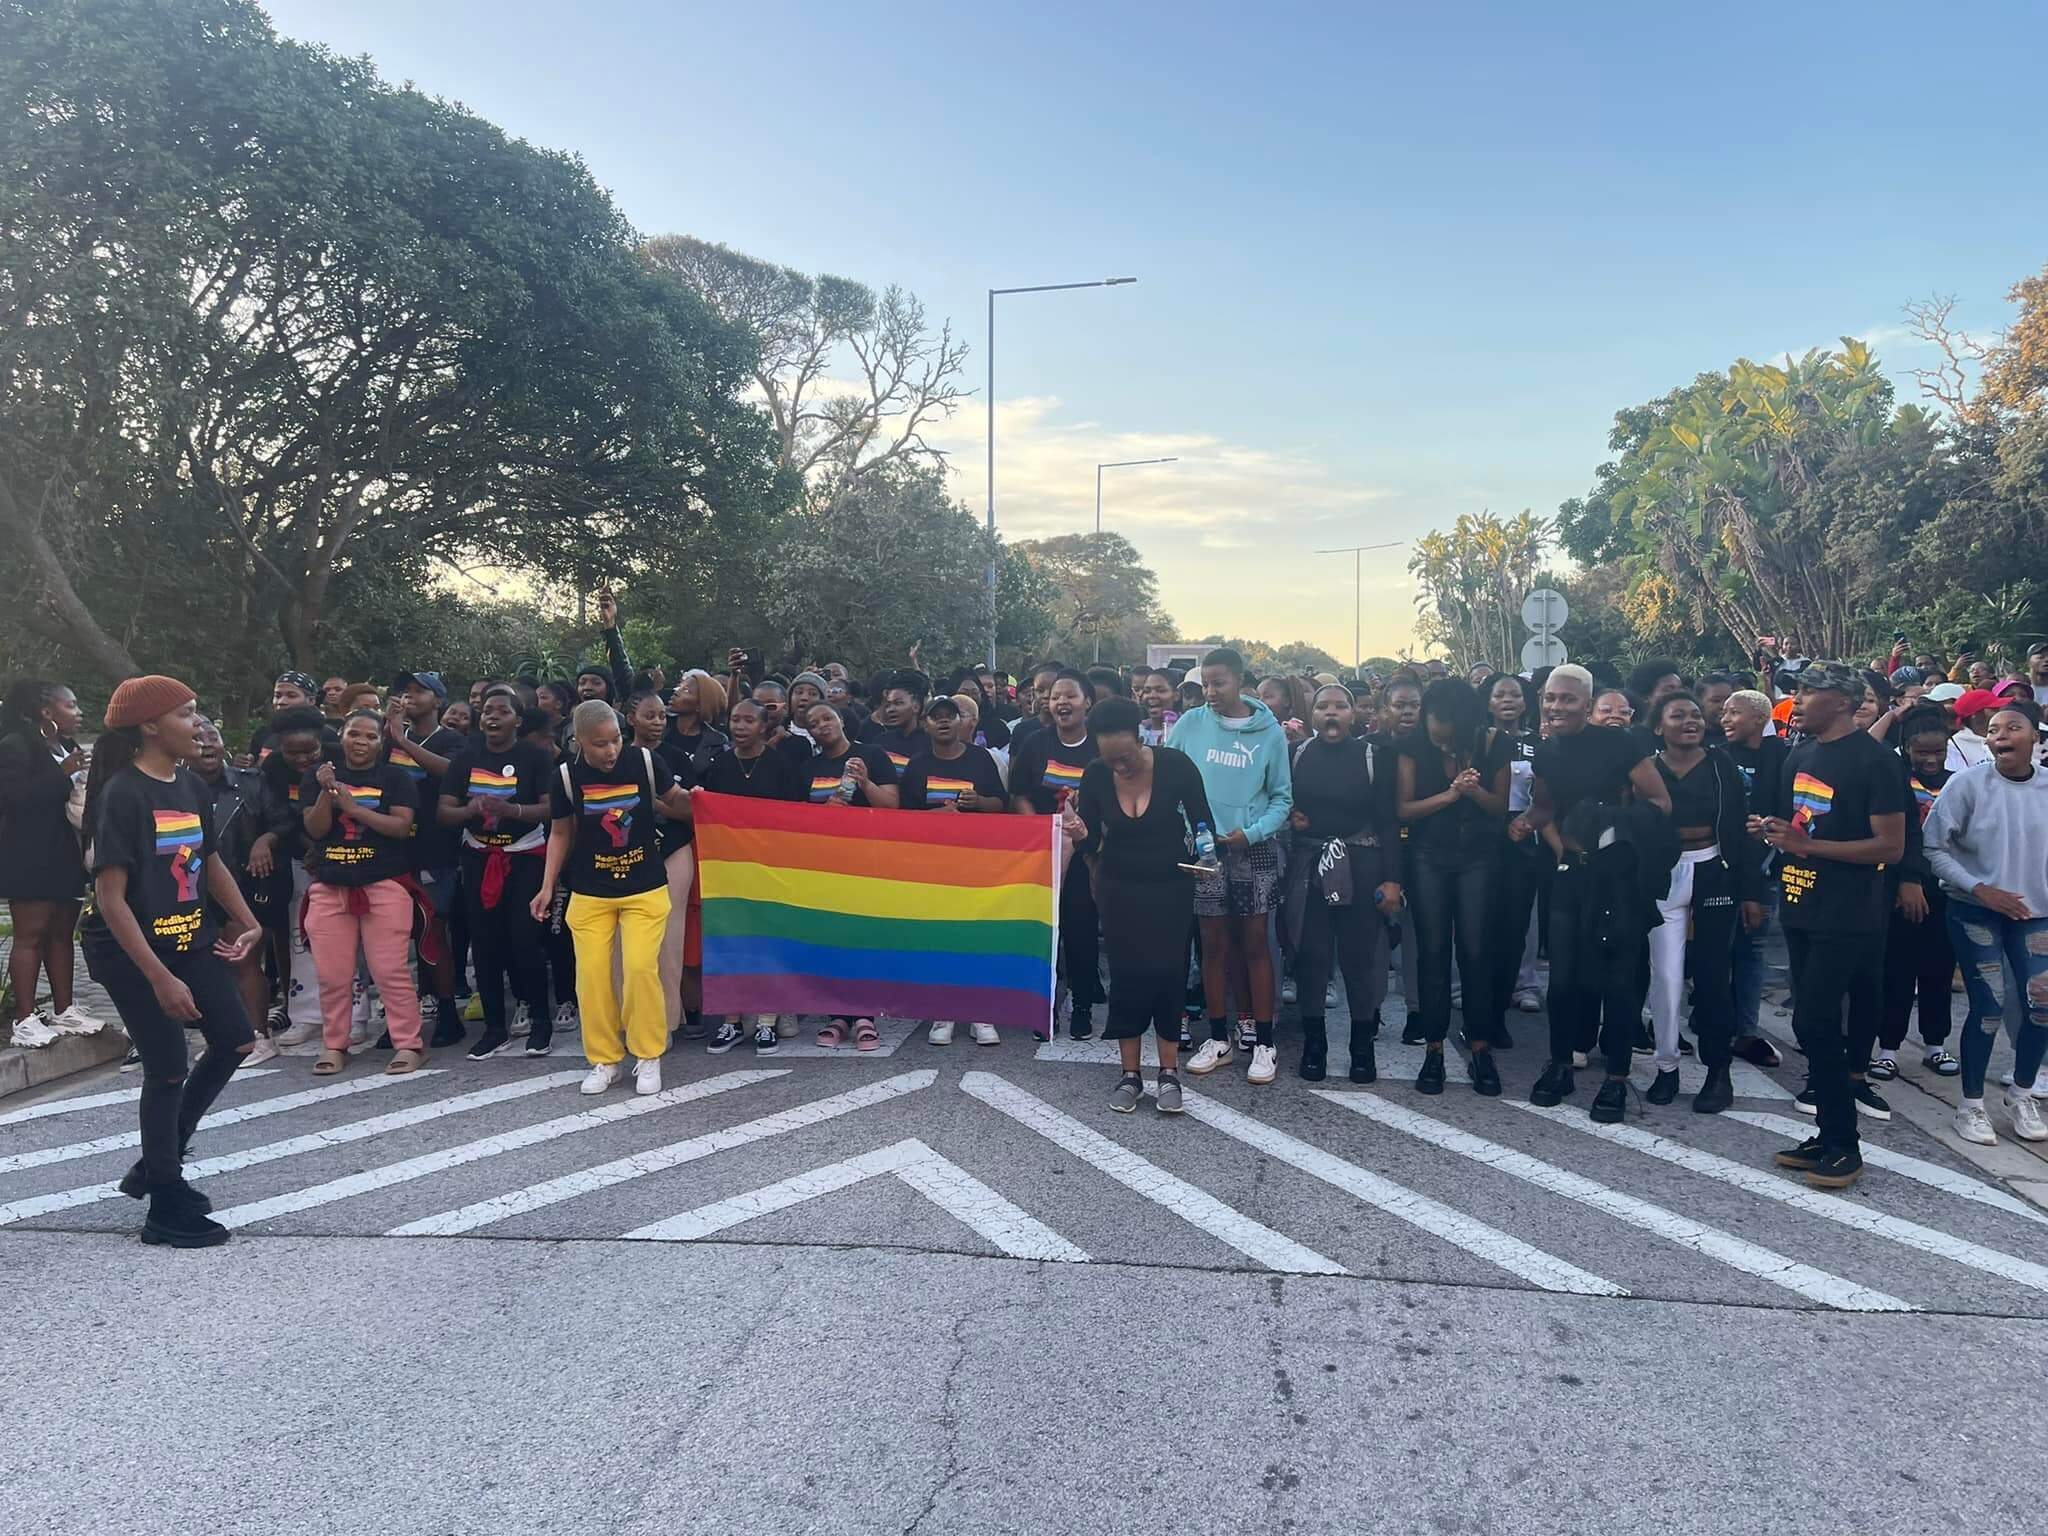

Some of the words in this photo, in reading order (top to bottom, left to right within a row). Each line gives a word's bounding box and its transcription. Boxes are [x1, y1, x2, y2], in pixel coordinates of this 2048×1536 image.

[1206, 748, 1247, 769] PUMA
[153, 914, 193, 927] Madiba
[154, 923, 188, 936] PRIDE
